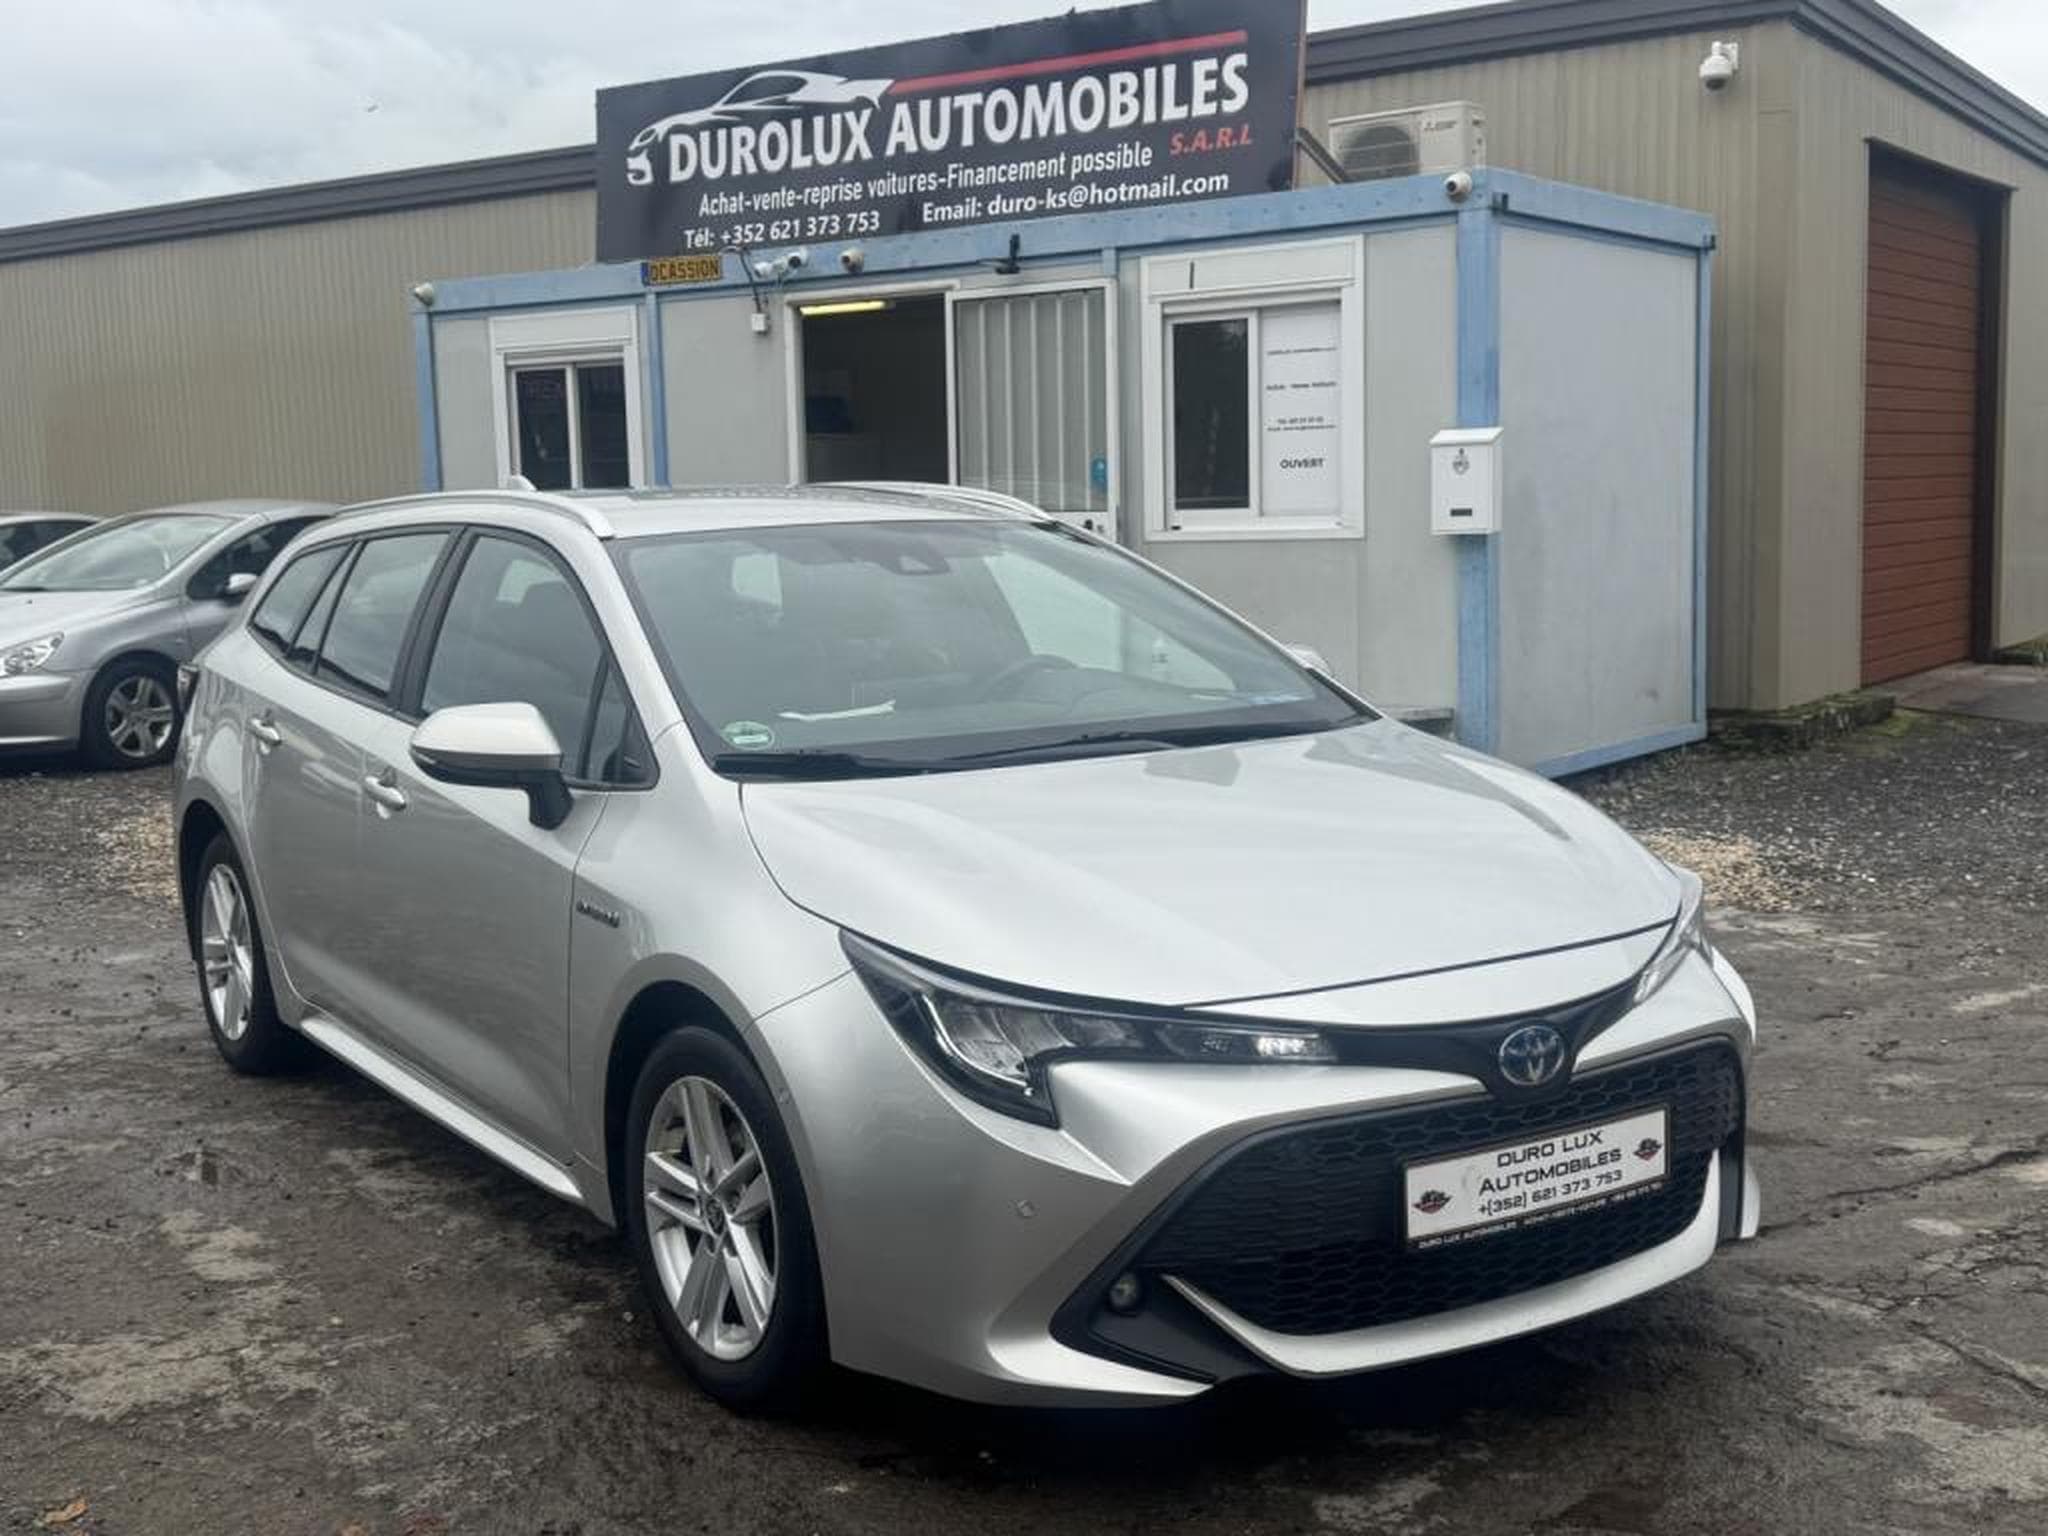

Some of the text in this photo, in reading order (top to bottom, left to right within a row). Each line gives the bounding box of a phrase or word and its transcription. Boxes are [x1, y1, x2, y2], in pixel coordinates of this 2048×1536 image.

[669, 53, 1249, 183] DUROLUX AUTOMOBILES
[699, 141, 1153, 217] Achat-vente-reprise voitures-Financement possible
[922, 172, 1230, 223] Email: duro-ks@hotmail.com
[720, 223, 764, 244] +352
[770, 218, 801, 240] 621
[807, 215, 840, 237] 373
[848, 211, 880, 232] 753
[1279, 457, 1325, 469] OUVERT
[1496, 1130, 1605, 1168] DURO LUX
[1478, 1148, 1622, 1196] AUTOMOBILES
[1531, 1186, 1557, 1203] 621
[1561, 1177, 1591, 1196] 373
[1594, 1169, 1622, 1187] 753
